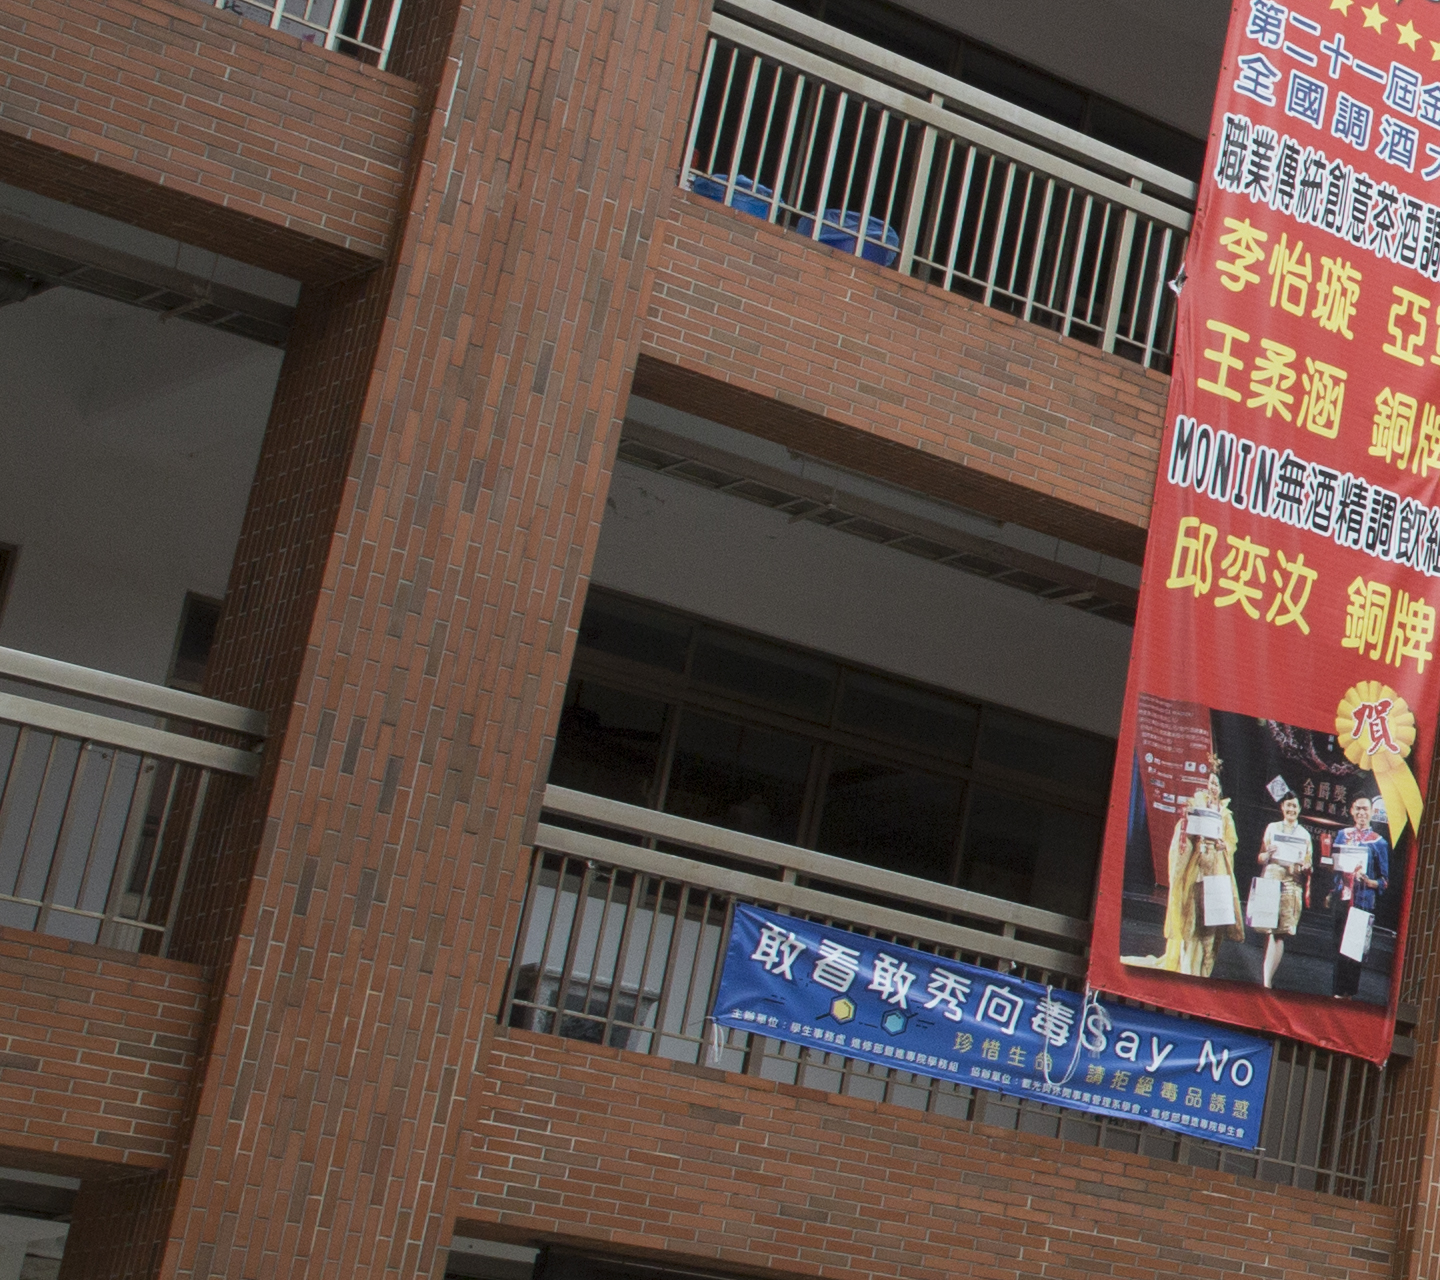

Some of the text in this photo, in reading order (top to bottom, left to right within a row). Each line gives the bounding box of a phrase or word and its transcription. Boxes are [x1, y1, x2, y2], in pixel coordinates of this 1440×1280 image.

[1215, 217, 1361, 339] 李怡璇
[1197, 319, 1348, 439] 王柔涵
[1341, 576, 1436, 674] 銅牌
[1351, 699, 1400, 755] 賀
[1081, 1014, 1174, 1073] Say
[1195, 1040, 1254, 1087] No
